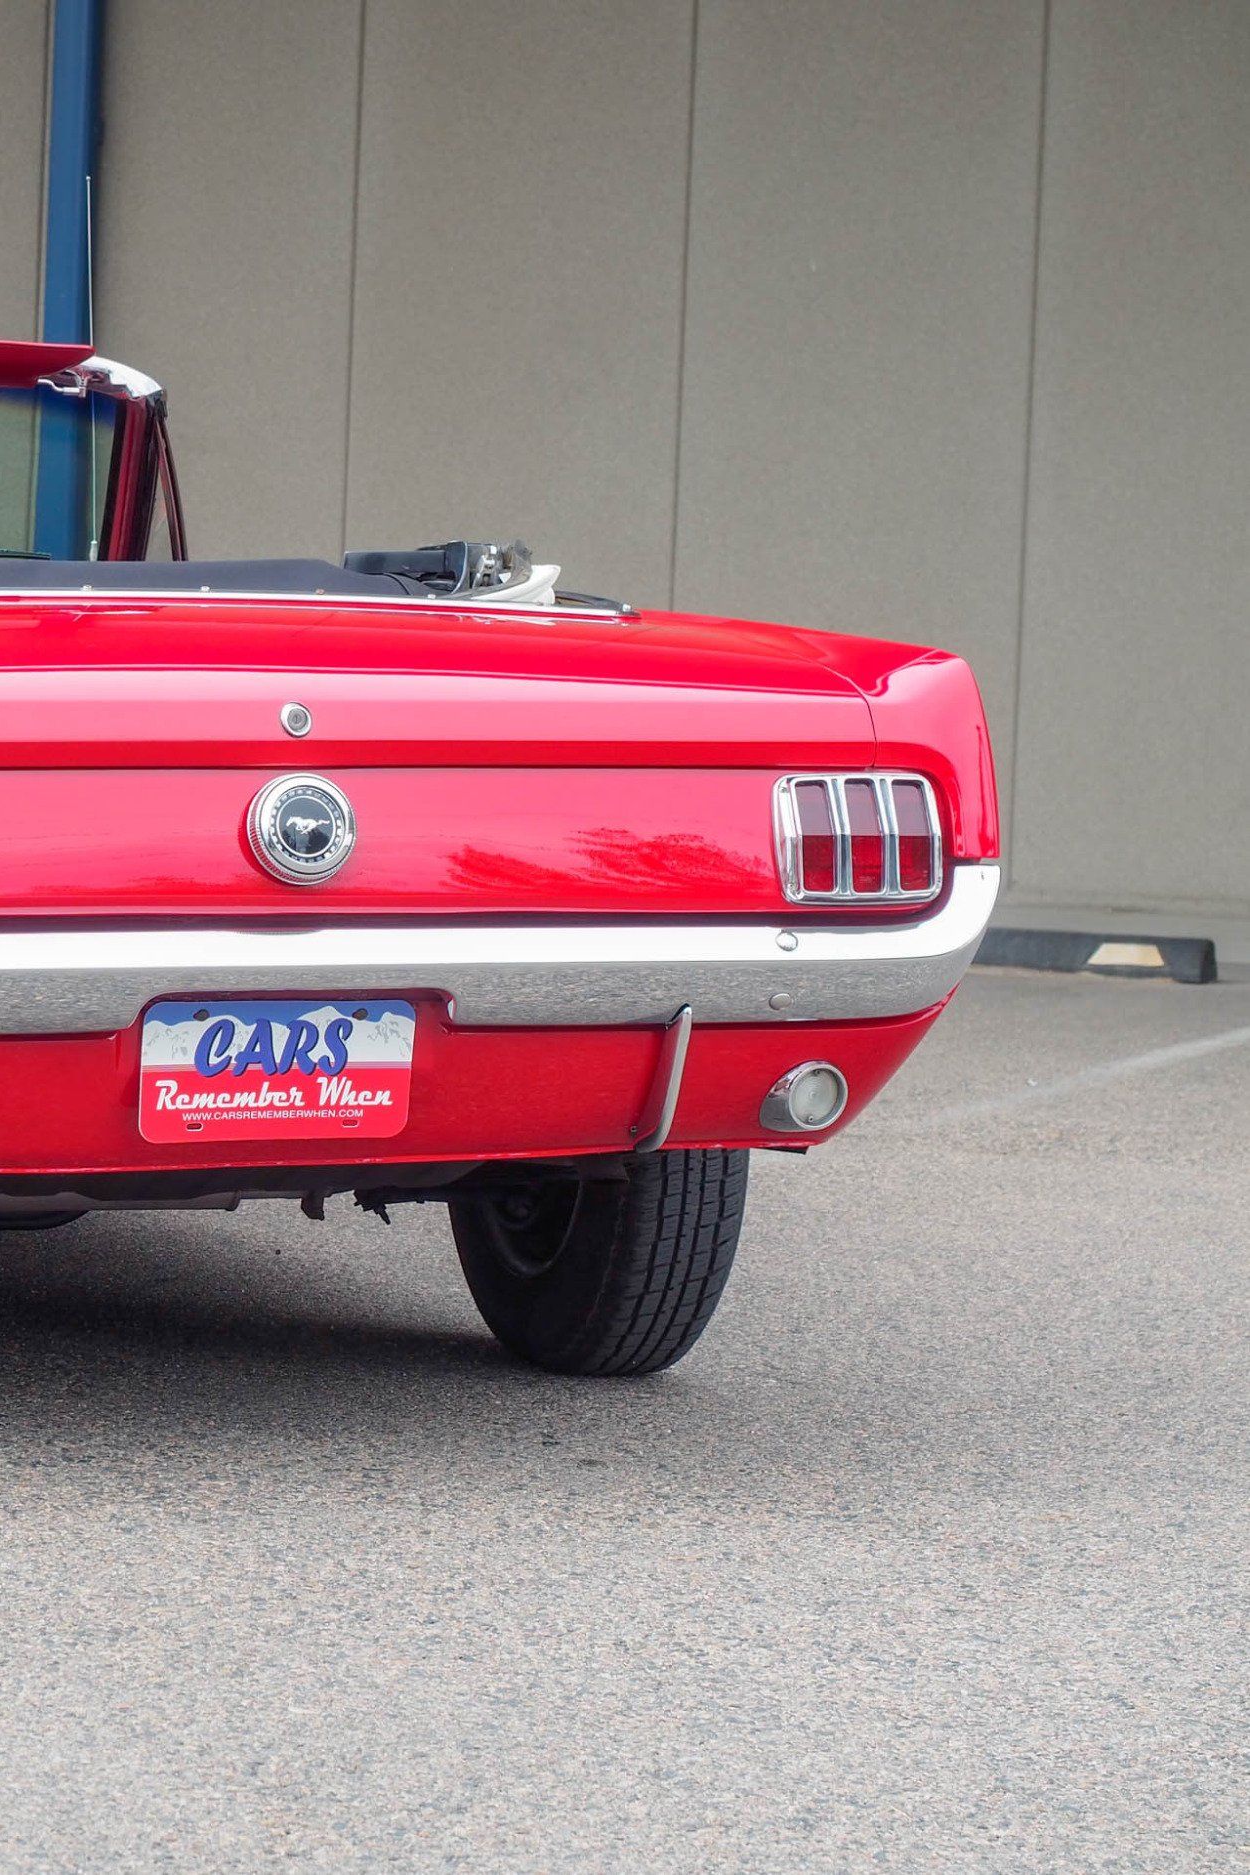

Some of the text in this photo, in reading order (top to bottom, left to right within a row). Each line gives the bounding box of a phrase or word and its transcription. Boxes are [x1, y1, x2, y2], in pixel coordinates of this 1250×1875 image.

[194, 1018, 353, 1077] CARS
[155, 1076, 393, 1110] Remember When
[182, 1110, 364, 1121] WWW.CARSREMEMBERWHEN.COM
